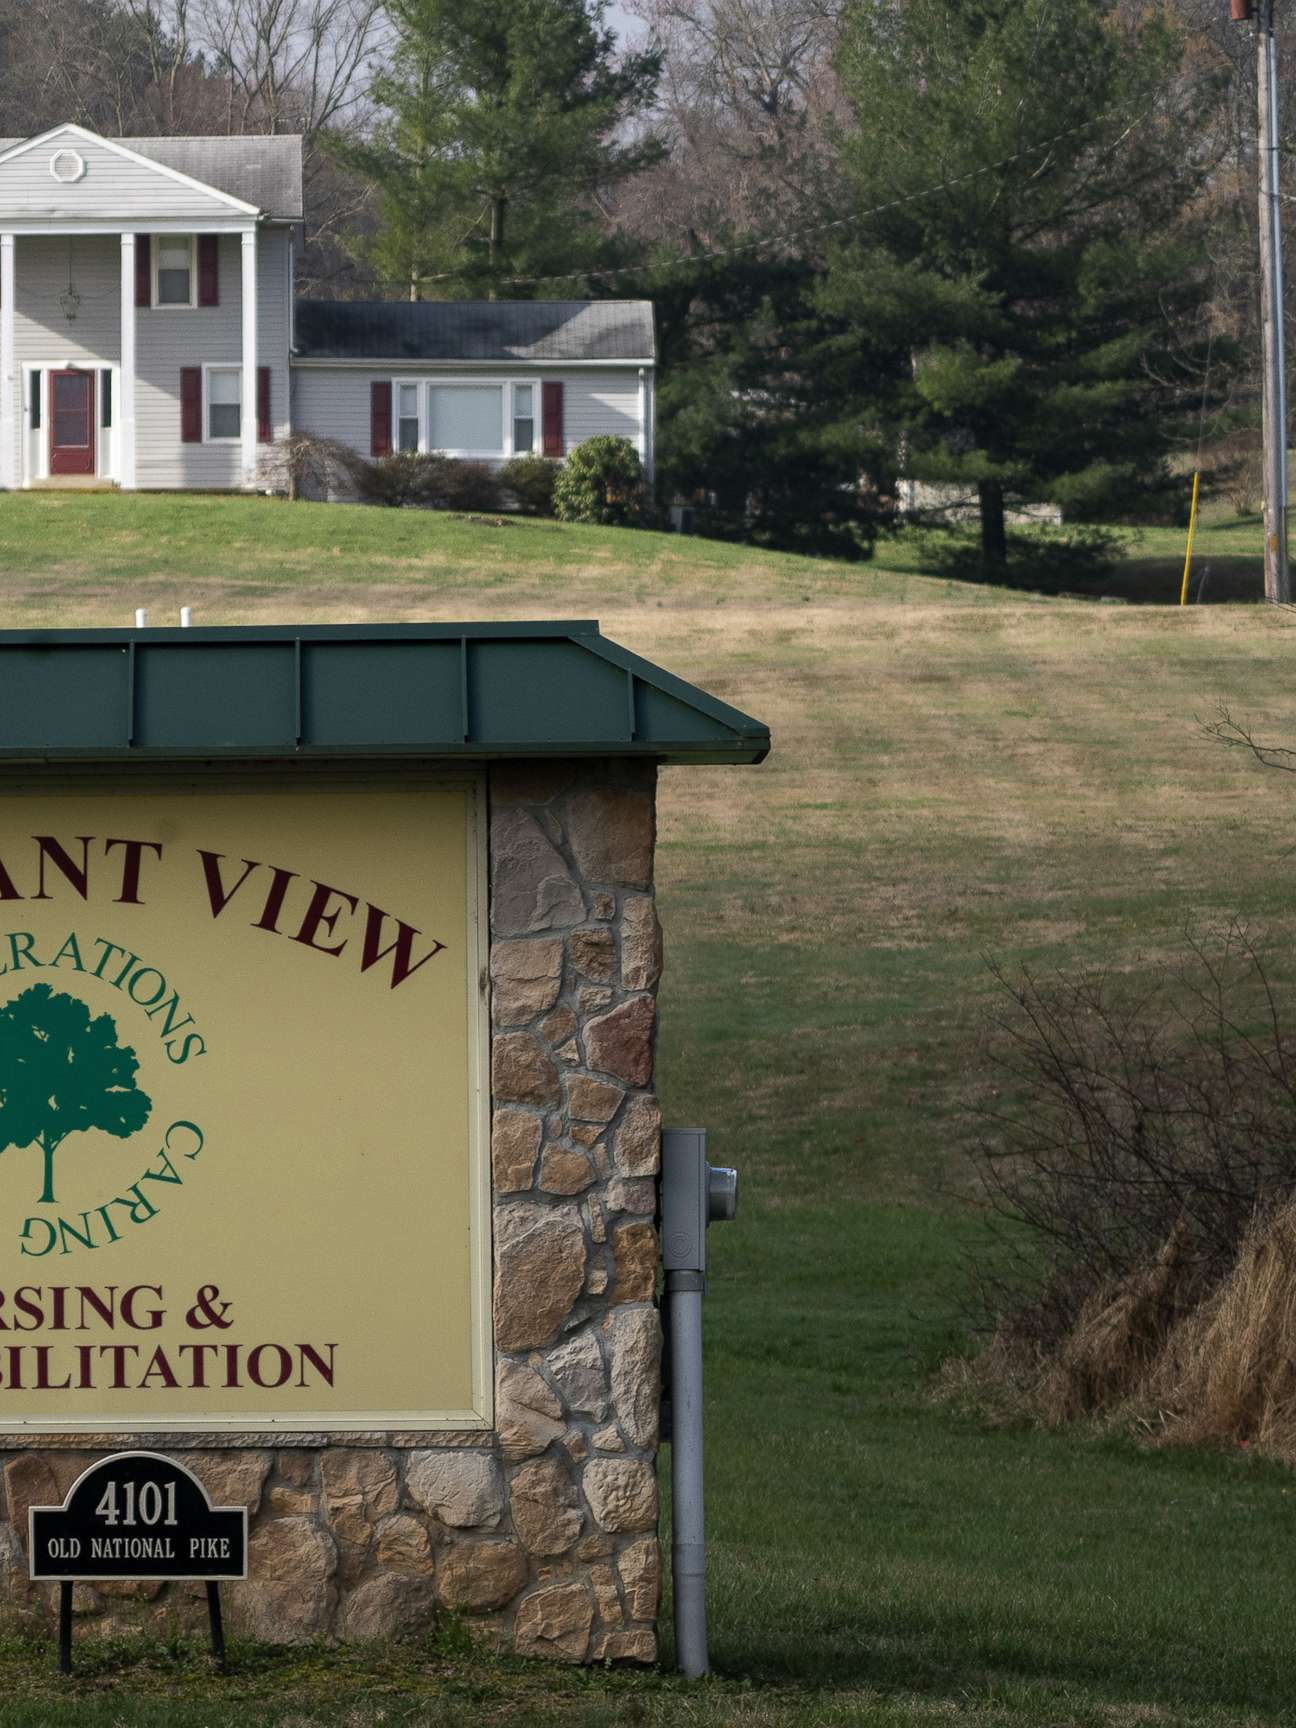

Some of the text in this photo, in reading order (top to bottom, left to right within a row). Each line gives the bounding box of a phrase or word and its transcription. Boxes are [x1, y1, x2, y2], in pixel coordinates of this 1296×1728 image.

[196, 848, 448, 991] VIEW
[18, 1119, 206, 1257] CARING
[185, 1284, 235, 1330] &
[95, 1481, 178, 1526] 4101
[47, 1537, 230, 1559] OLD NATIONAL PIKE
